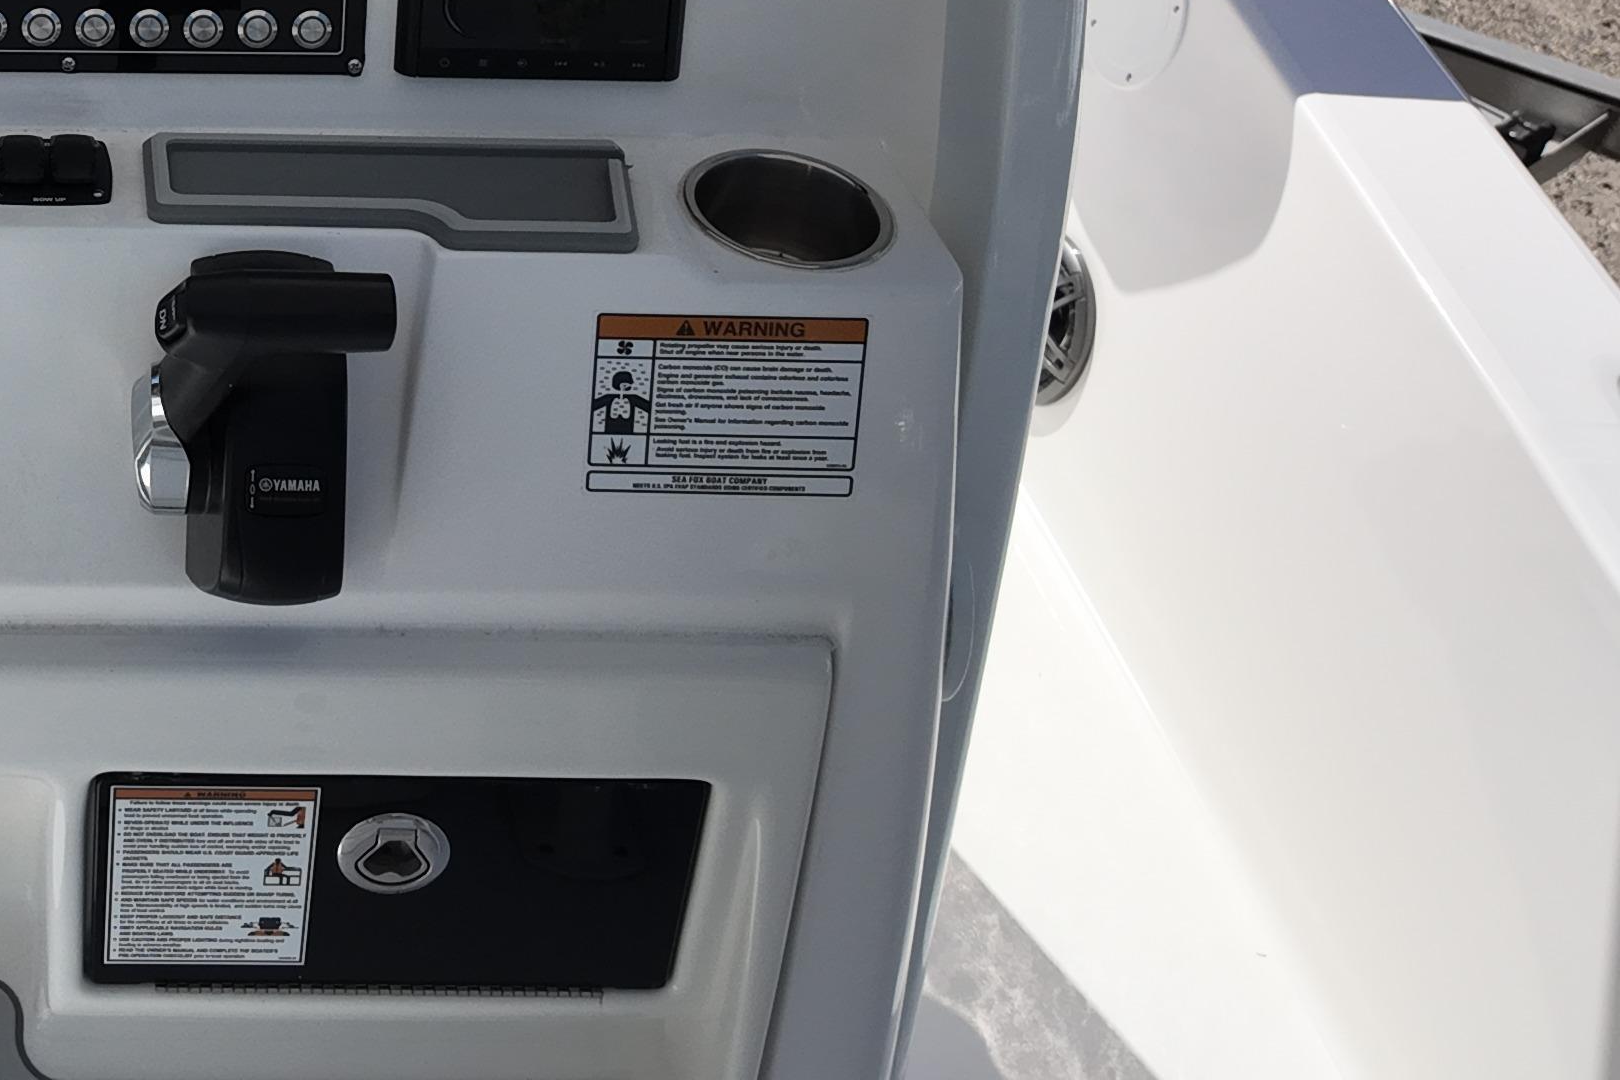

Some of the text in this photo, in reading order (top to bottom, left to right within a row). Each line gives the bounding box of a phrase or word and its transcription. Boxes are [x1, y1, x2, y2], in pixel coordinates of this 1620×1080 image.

[158, 308, 167, 330] DN
[704, 320, 806, 338] WARNING
[273, 479, 320, 493] YAMAHA
